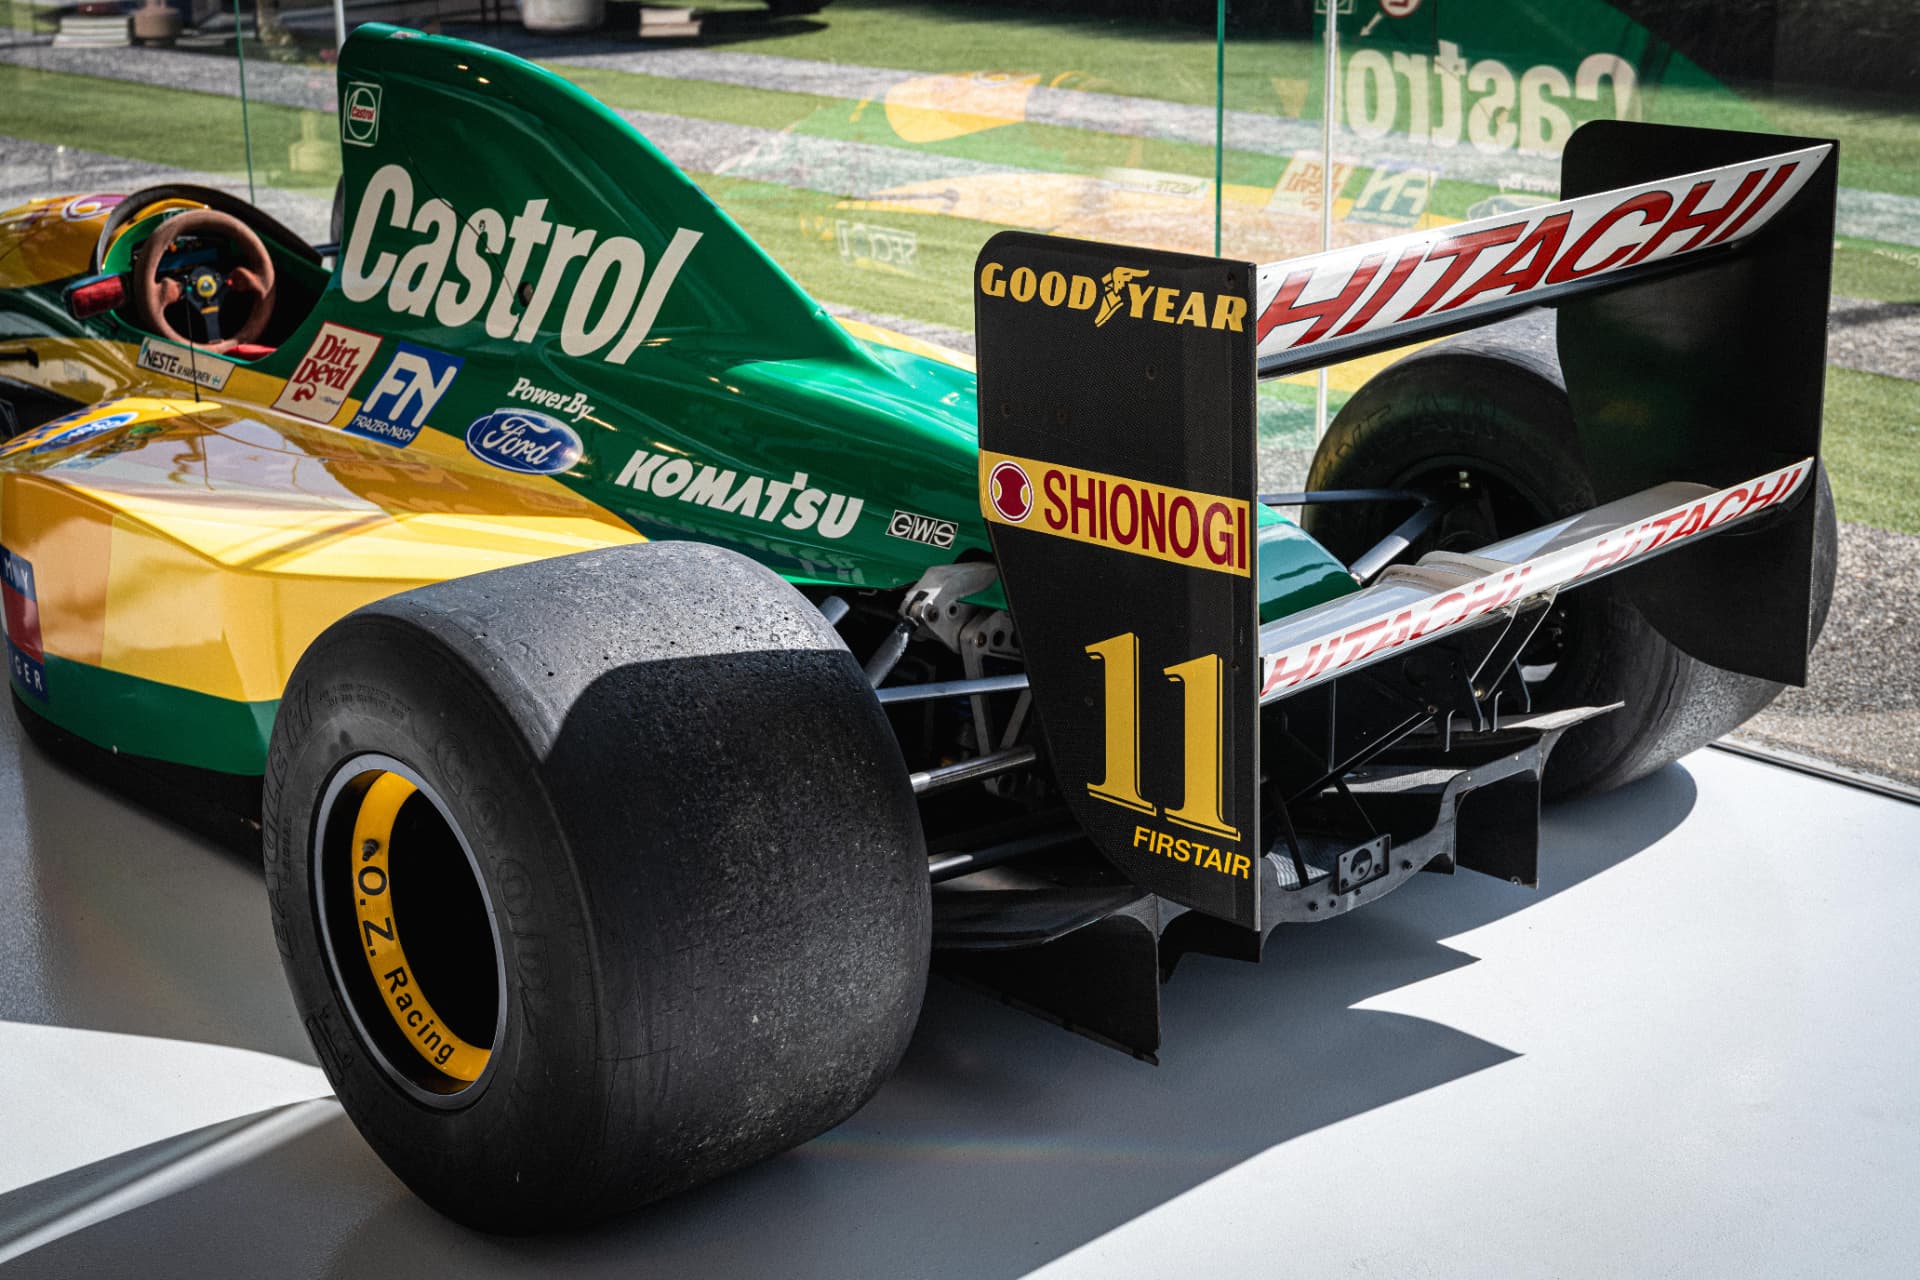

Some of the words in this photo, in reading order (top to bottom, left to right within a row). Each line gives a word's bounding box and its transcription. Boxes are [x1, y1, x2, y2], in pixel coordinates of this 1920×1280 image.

[351, 106, 374, 120] Castrol
[341, 164, 703, 364] Castrol
[1257, 161, 1800, 348] HITACHI
[980, 262, 1097, 311] GOOD
[1127, 285, 1248, 332] YEAR
[144, 348, 180, 374] NESTE
[291, 358, 361, 391] Devil
[314, 333, 360, 368] Dirt
[363, 351, 458, 427] FN
[352, 414, 416, 442] FRAZER-NASH
[482, 416, 559, 465] Ford
[614, 449, 864, 539] KOMATSU
[1043, 469, 1248, 570] SHIONOGI
[1575, 468, 1801, 578] HITACHI
[889, 513, 957, 549] GWS
[1260, 566, 1532, 697] HITACHI
[1085, 631, 1241, 842] 11
[1132, 825, 1251, 880] FIRSTAIR
[384, 966, 455, 1066] Racing
